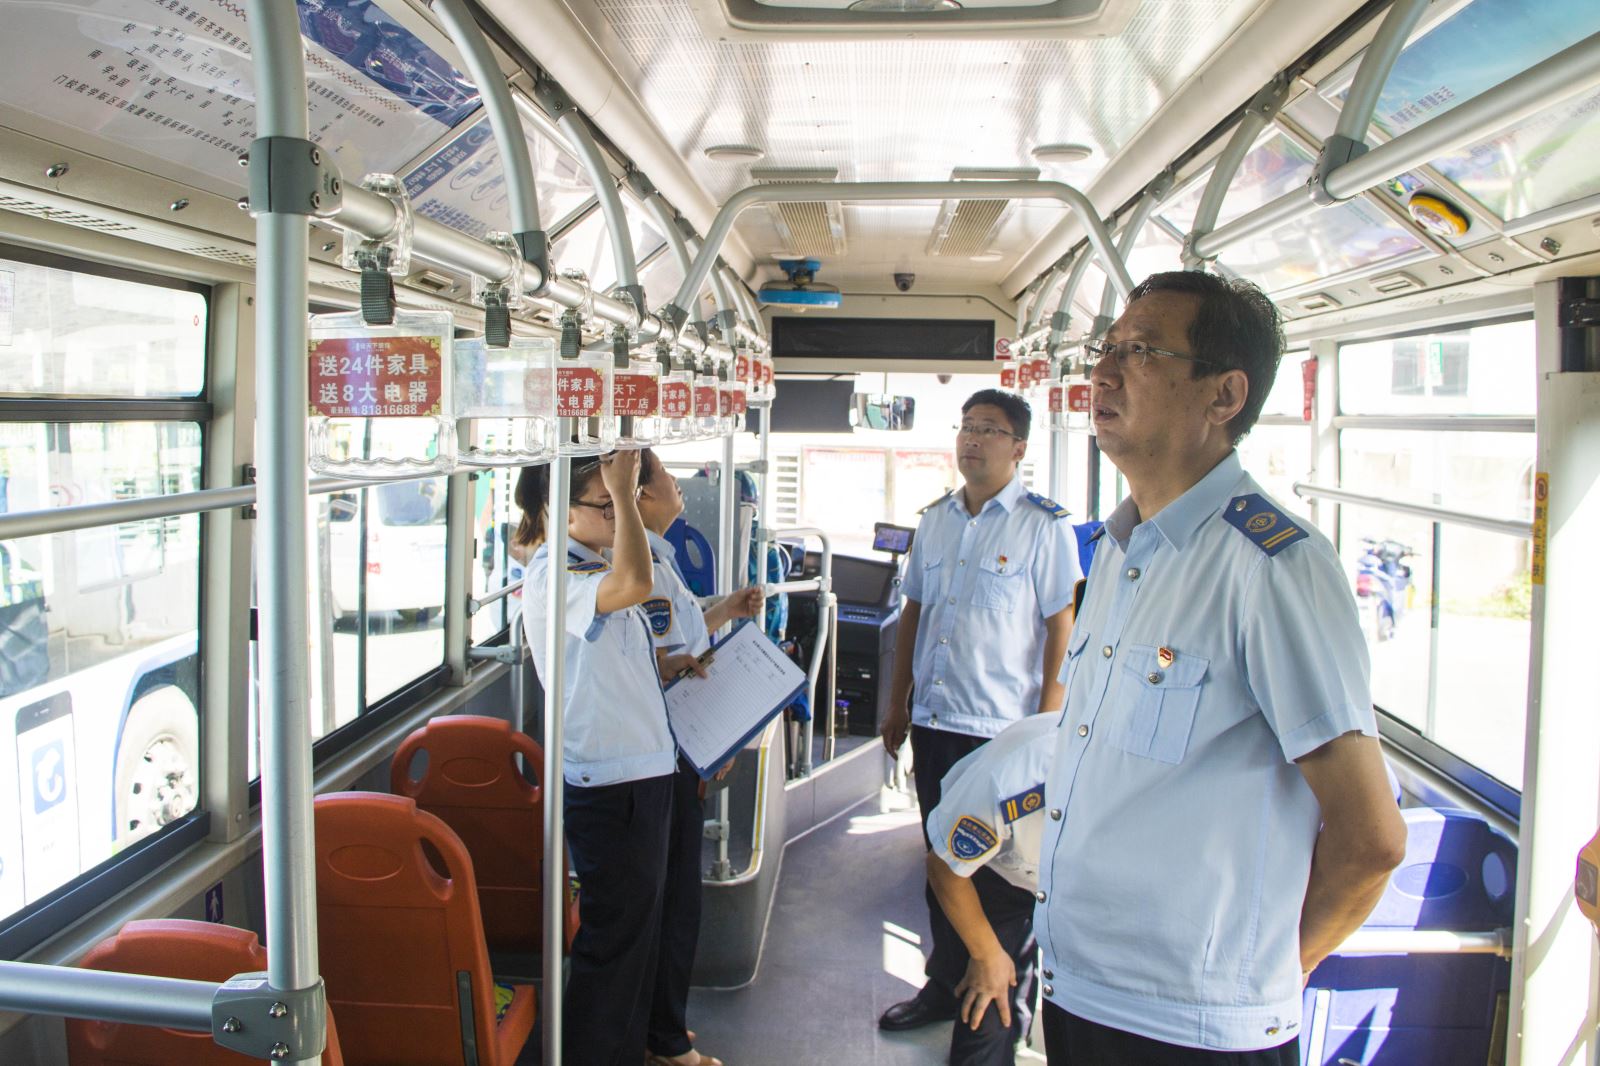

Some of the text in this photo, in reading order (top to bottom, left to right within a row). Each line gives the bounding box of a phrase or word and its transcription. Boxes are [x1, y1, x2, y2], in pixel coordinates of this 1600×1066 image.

[319, 354, 429, 376] 送24件家具
[319, 381, 428, 404] 送8大电器
[361, 404, 417, 415] 81816688
